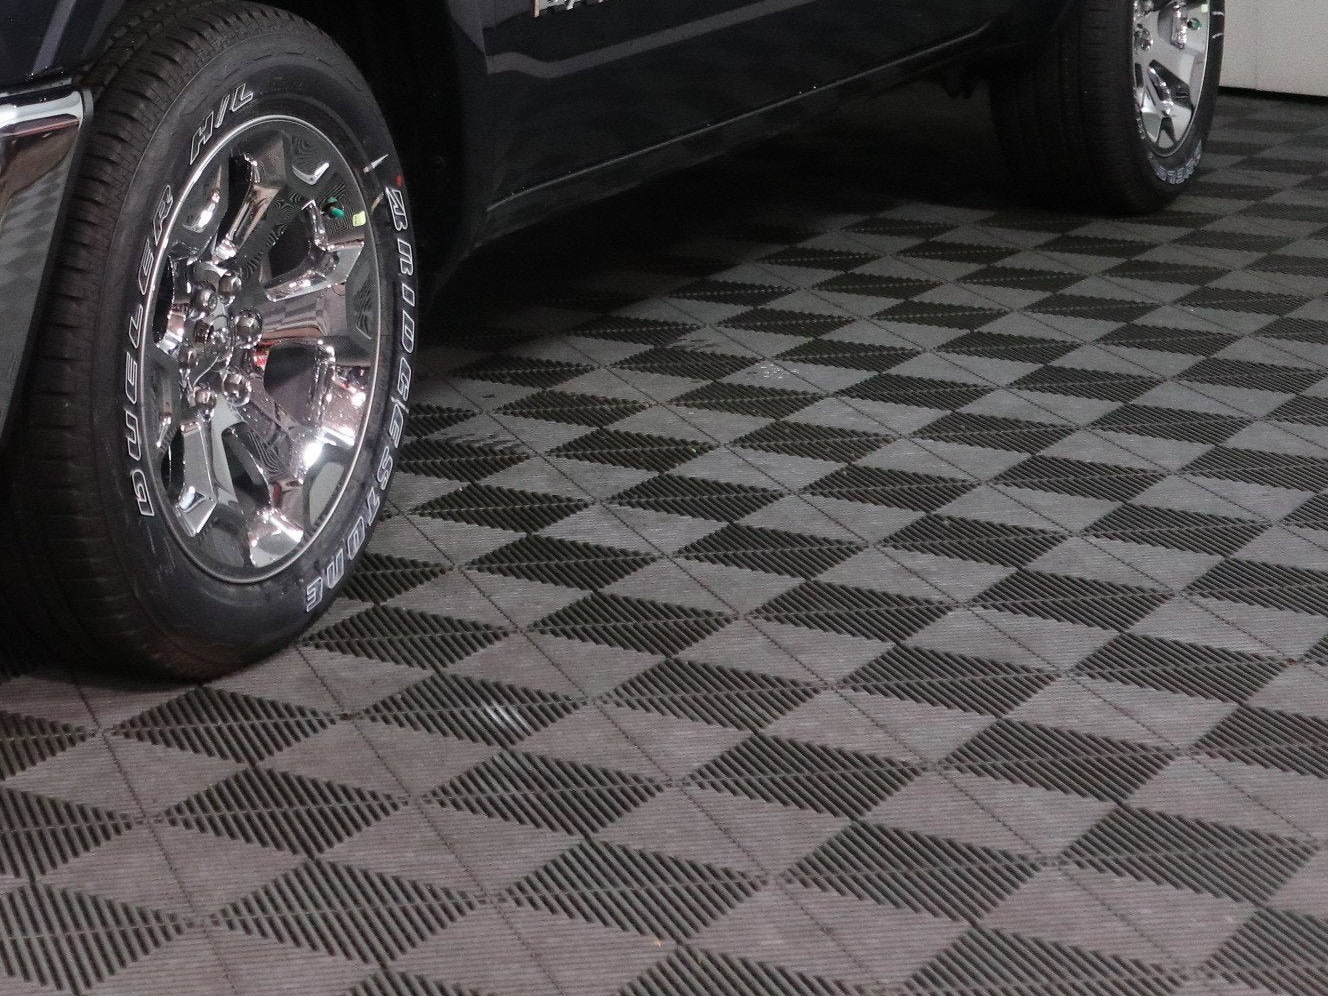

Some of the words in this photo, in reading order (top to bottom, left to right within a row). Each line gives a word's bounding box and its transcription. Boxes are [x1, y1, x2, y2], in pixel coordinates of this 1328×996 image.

[125, 184, 174, 517] DUELER
[189, 82, 255, 166] H/L
[305, 187, 416, 613] BRIDGESTONE
